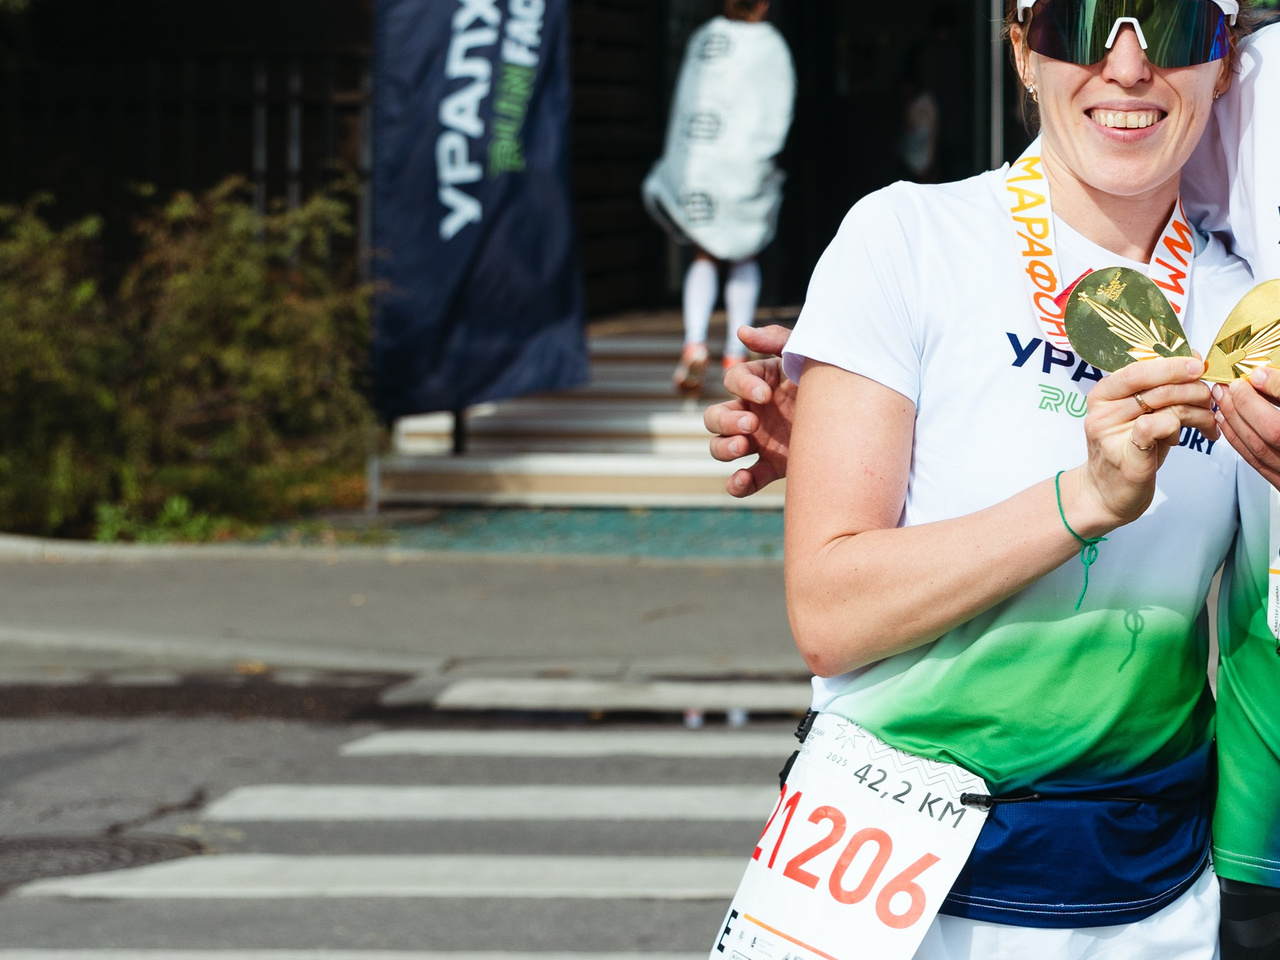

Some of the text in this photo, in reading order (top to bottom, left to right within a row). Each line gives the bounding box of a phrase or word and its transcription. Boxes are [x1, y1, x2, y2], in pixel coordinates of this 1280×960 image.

[1006, 156, 1070, 343] МАРАФОН
[1038, 383, 1088, 418] RU
[826, 751, 848, 767] 2025
[853, 763, 912, 805] 42,2
